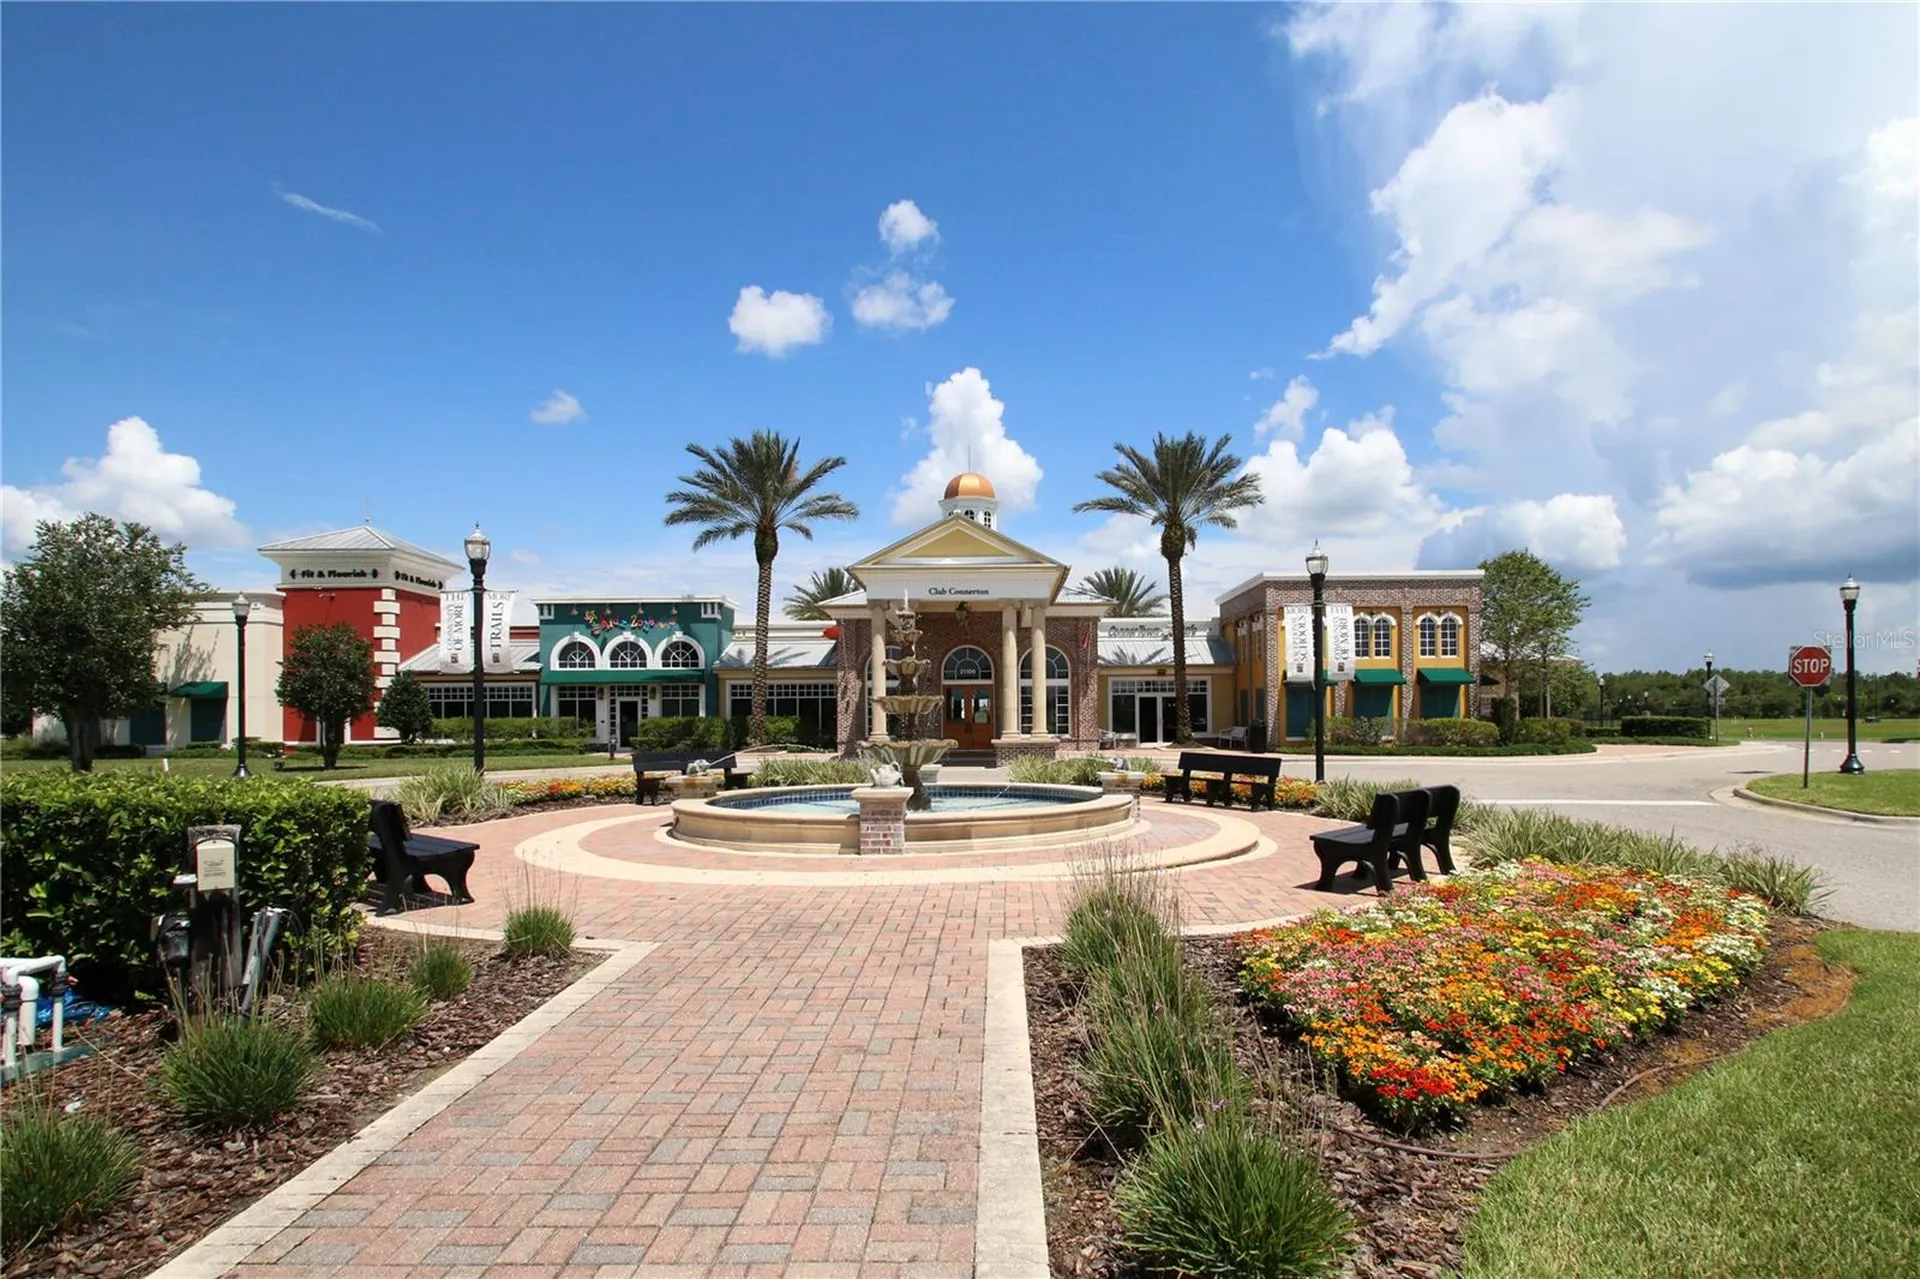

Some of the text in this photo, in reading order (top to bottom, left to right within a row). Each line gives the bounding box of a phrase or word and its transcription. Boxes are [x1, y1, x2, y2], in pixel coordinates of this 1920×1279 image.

[328, 569, 367, 579] Flourish
[928, 587, 989, 595] Club Connerton
[490, 601, 504, 652] TRAILS
[1298, 615, 1308, 662] SCHOOLS
[1793, 659, 1830, 674] STOP
